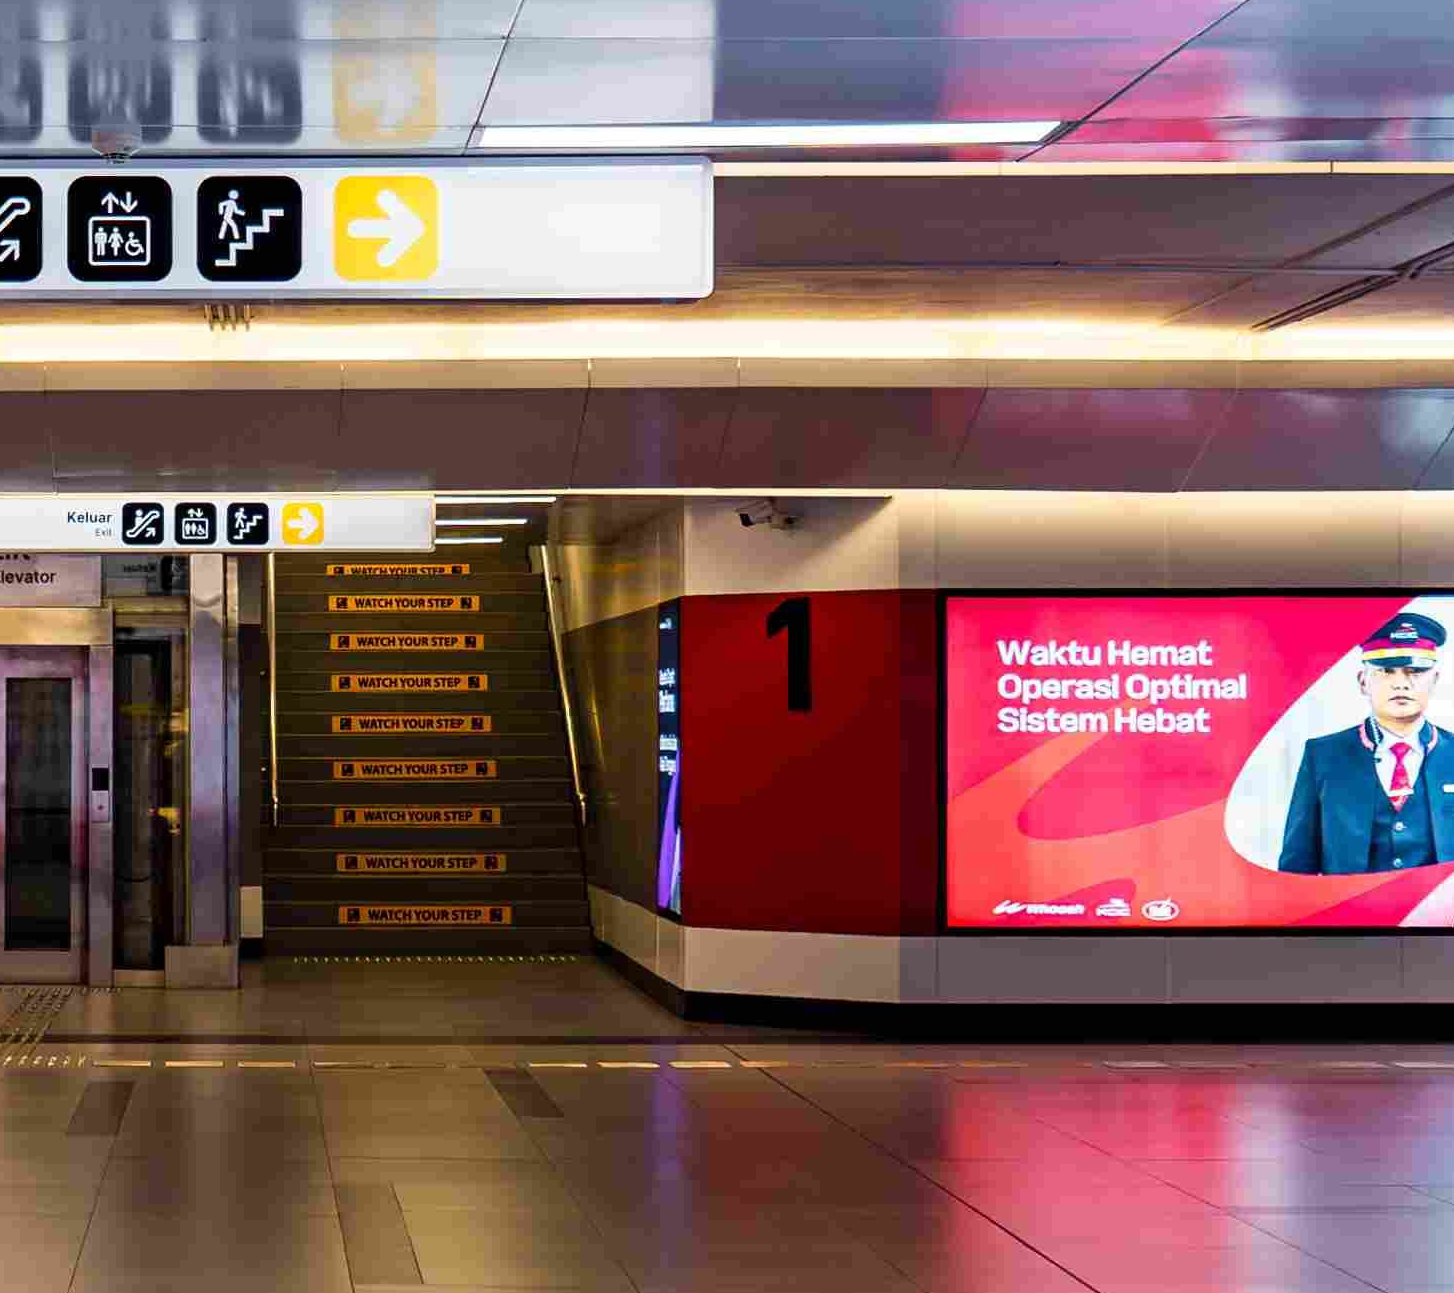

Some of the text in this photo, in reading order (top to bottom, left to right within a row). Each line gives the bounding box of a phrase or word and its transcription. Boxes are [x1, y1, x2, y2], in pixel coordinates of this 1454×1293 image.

[67, 511, 113, 524] Keluar
[354, 597, 454, 608] WATCH YOUR STEP
[357, 636, 458, 647] WATCH YOUR STEP
[767, 596, 810, 711] 1
[997, 640, 1213, 666] Waktu Hemat
[358, 677, 461, 688] WATCH YOUR STEP
[997, 673, 1248, 704] Operasi Optimal
[359, 717, 465, 729] WATCH YOUR STEP
[997, 708, 1211, 733] Sistem Hebat
[362, 764, 469, 775] WATCH YOUR STEP
[364, 811, 473, 822] WATCH YOUR STEP
[365, 857, 478, 869] WATCH YOUR STEP
[368, 909, 483, 921] WATCH YOUR STEP
